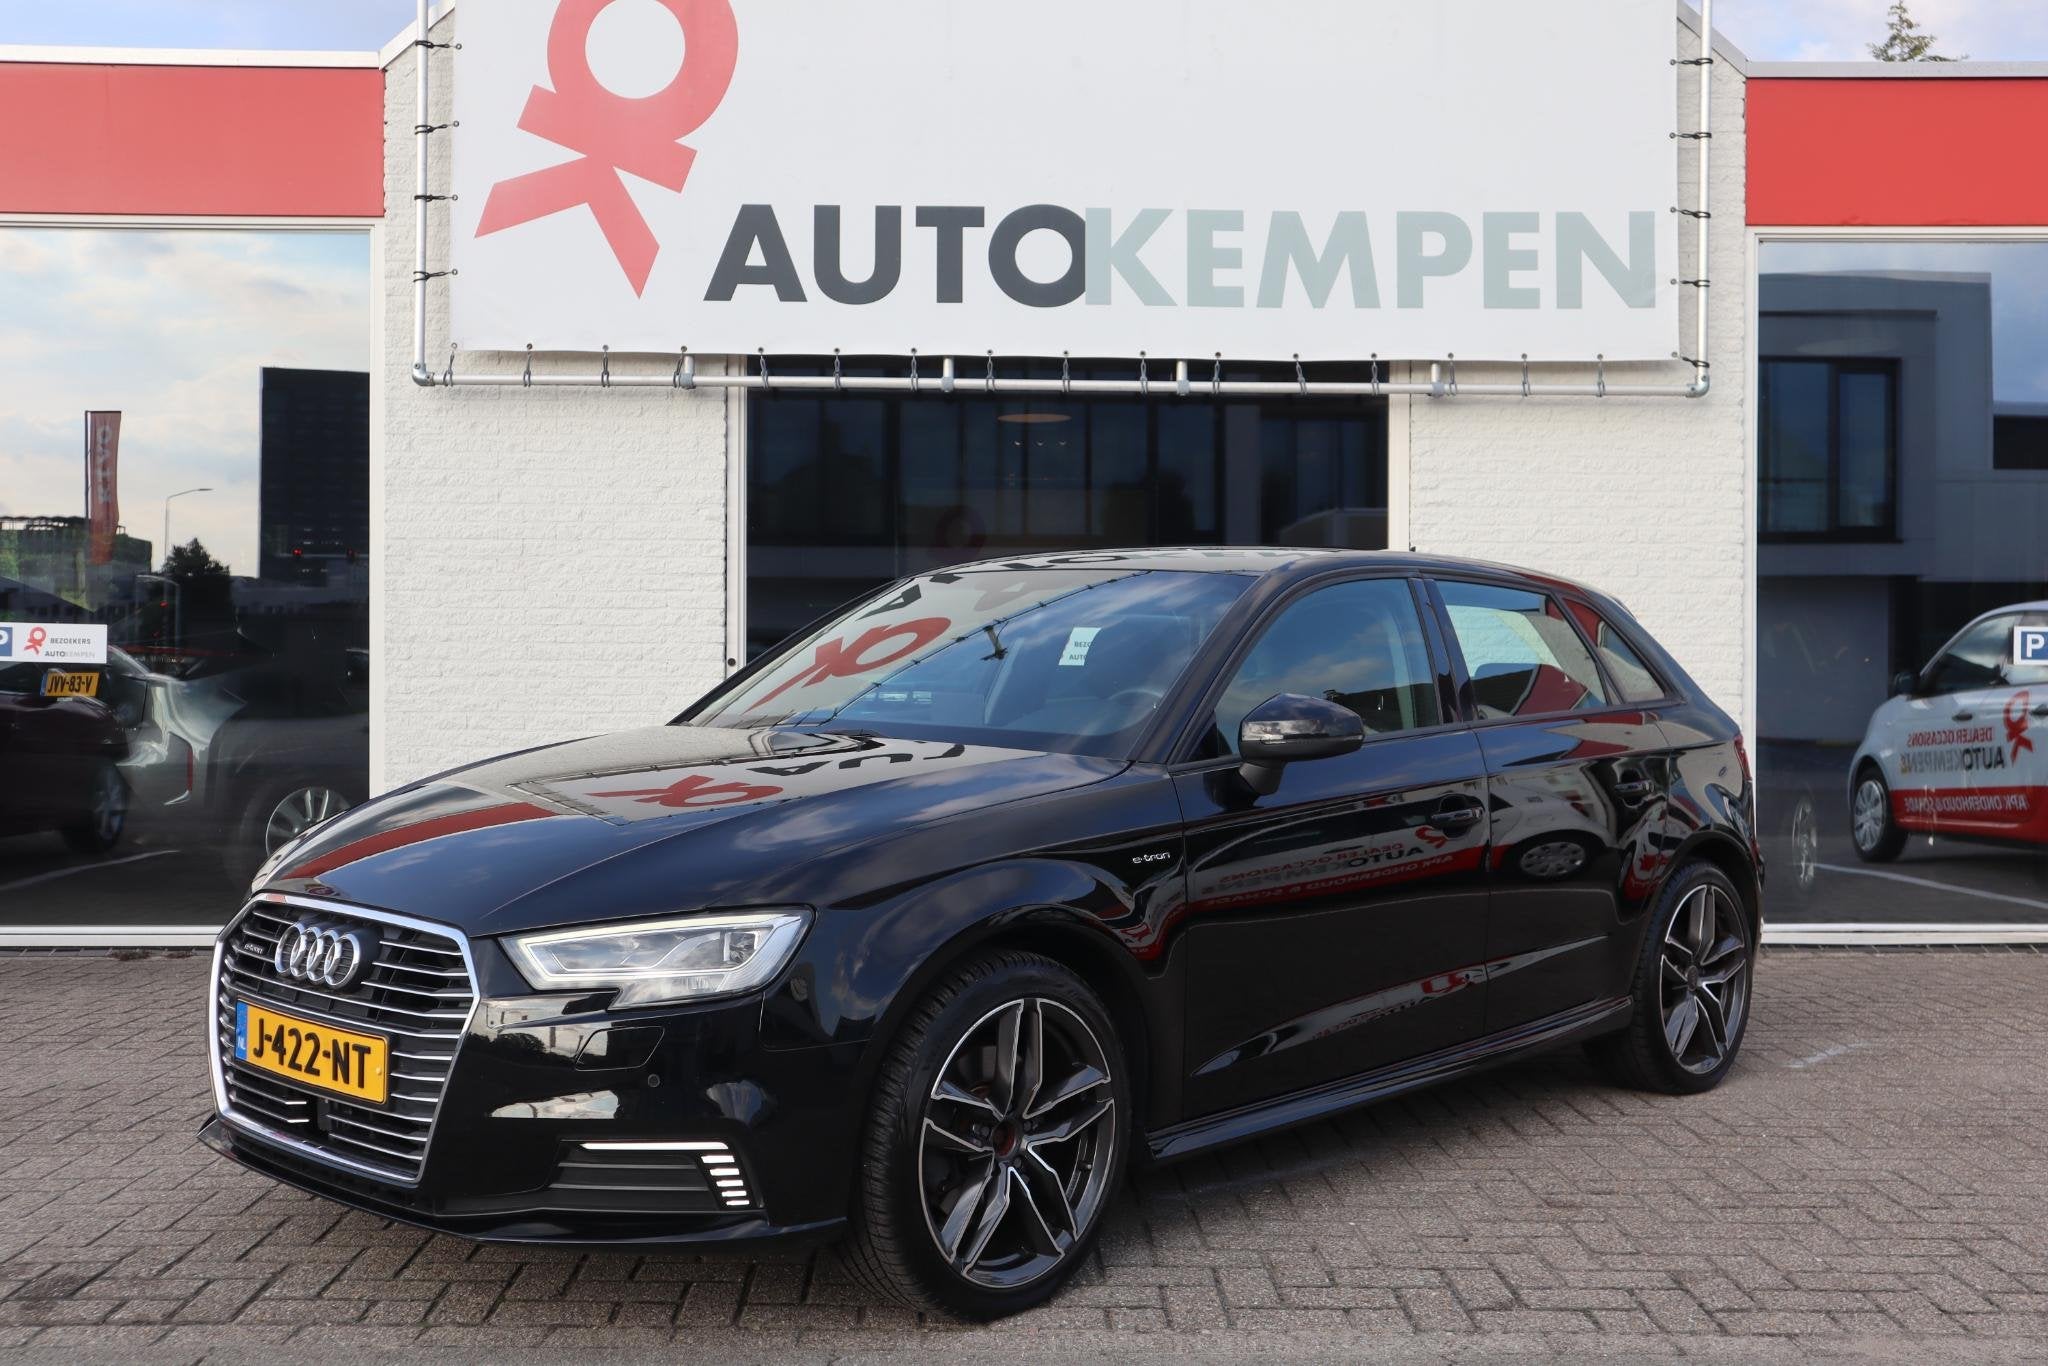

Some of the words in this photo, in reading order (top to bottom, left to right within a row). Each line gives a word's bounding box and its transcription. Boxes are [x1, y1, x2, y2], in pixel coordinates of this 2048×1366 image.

[703, 203, 1657, 309] AUTOKEMPEN
[2026, 633, 2045, 658] P
[253, 1018, 371, 1089] J-422-NT
